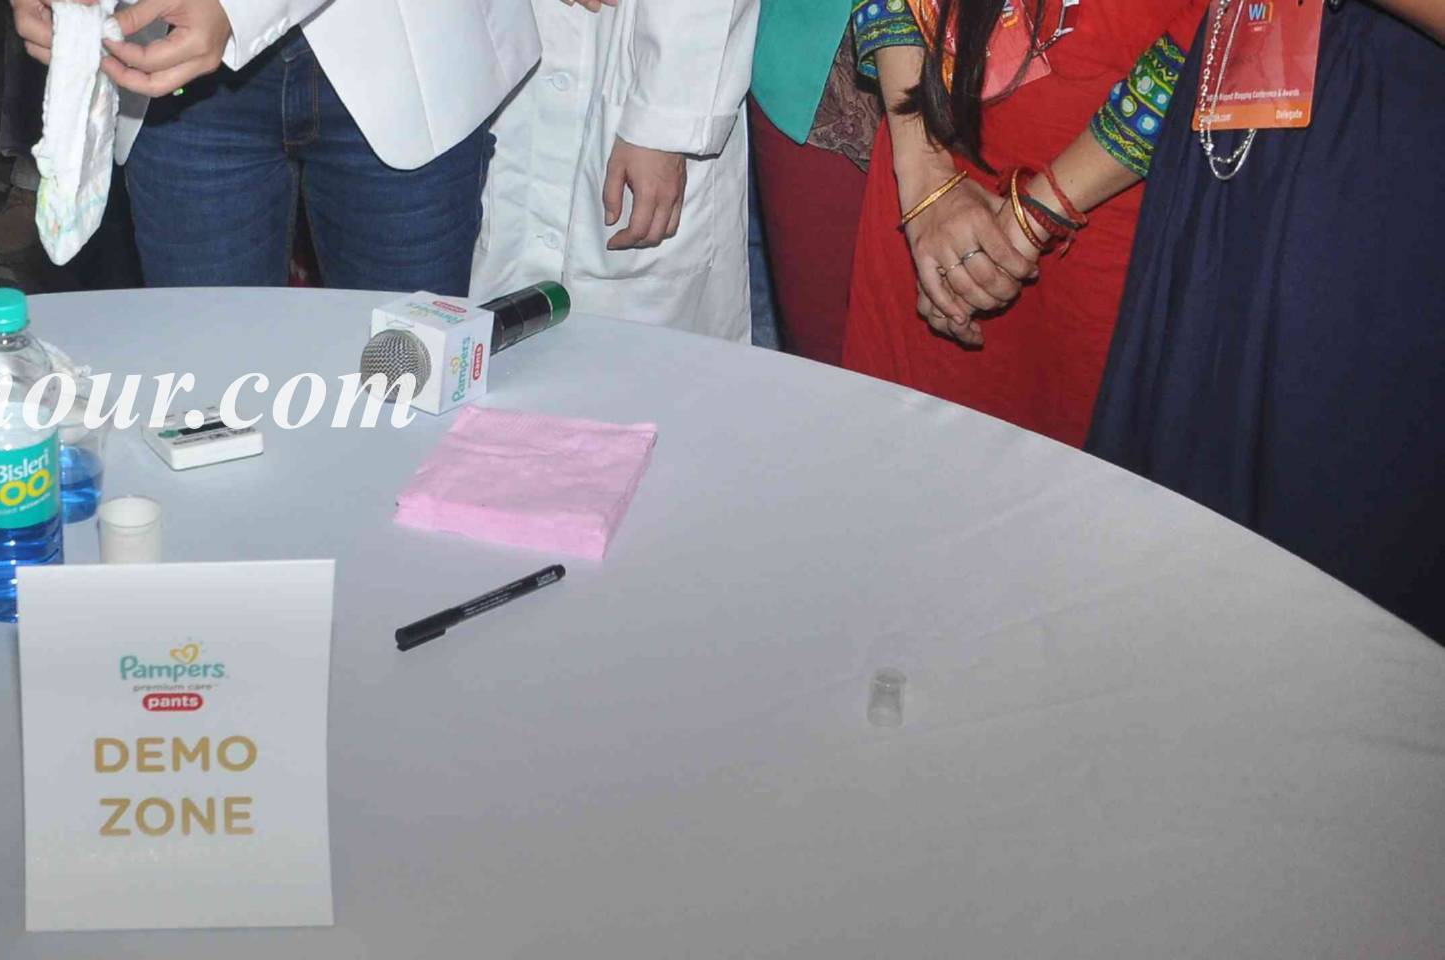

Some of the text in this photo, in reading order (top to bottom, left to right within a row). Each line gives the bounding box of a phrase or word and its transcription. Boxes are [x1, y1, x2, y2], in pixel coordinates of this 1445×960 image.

[452, 336, 471, 402] Pampers
[119, 654, 226, 682] Pampers
[132, 683, 213, 692] premium care
[148, 695, 199, 710] pants
[93, 735, 258, 774] DEMO
[98, 796, 254, 837] ZONE
